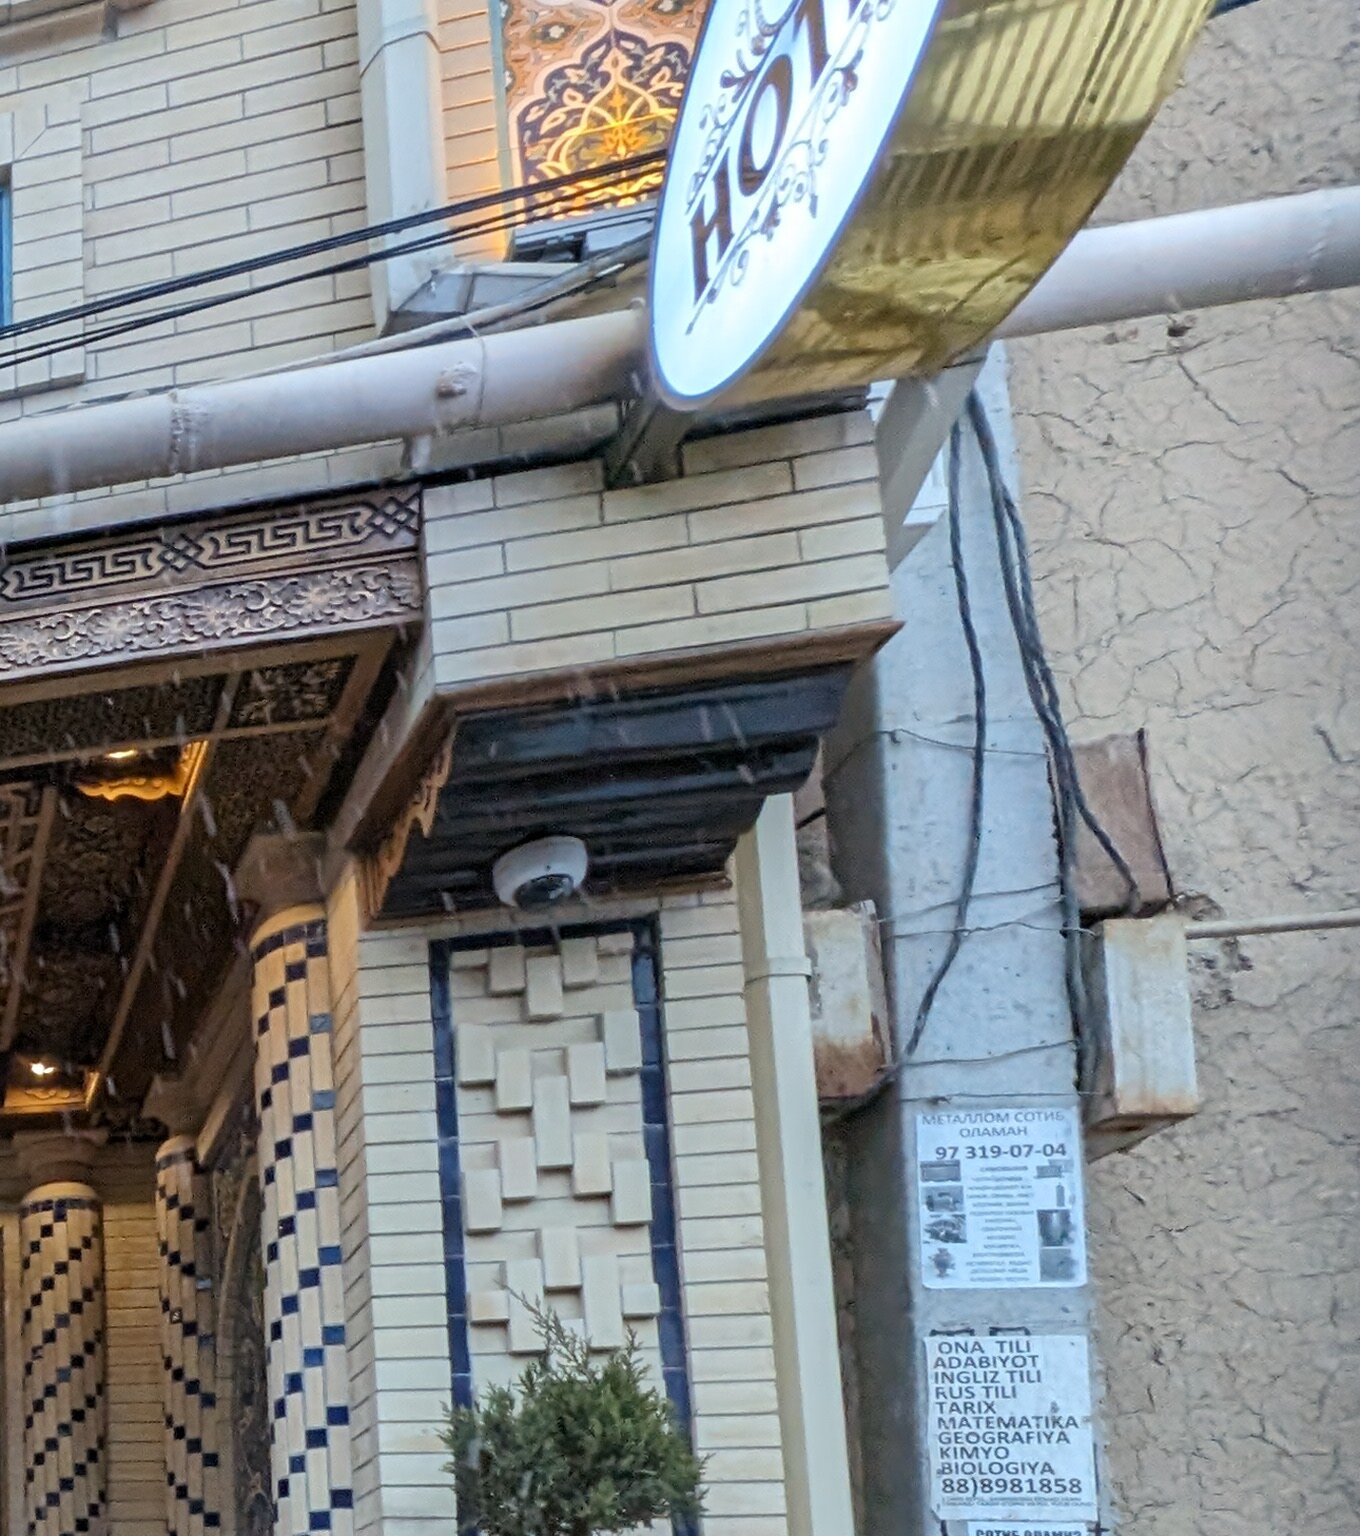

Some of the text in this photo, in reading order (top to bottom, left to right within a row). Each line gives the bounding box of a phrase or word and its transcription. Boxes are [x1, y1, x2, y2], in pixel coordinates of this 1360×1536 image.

[689, 0, 860, 306] HOT
[922, 1110, 1065, 1126] МЕТАЛЛОМ СОТИБ
[959, 1126, 1028, 1138] ОЛАМАН
[935, 1143, 1067, 1160] 97 319-07-04
[938, 1340, 1031, 1354] ONA TILI
[933, 1355, 1039, 1369] ADABIYOT
[934, 1370, 1042, 1384] INGLIZ TILI
[935, 1385, 1017, 1399] RUS TILI
[936, 1401, 997, 1414] TARIX
[937, 1415, 1079, 1430] MATEMATIKA
[938, 1431, 1071, 1444] GEOGRAFIYA
[940, 1446, 1010, 1459] KIMYO
[941, 1461, 1055, 1475] BIOLOGIYA
